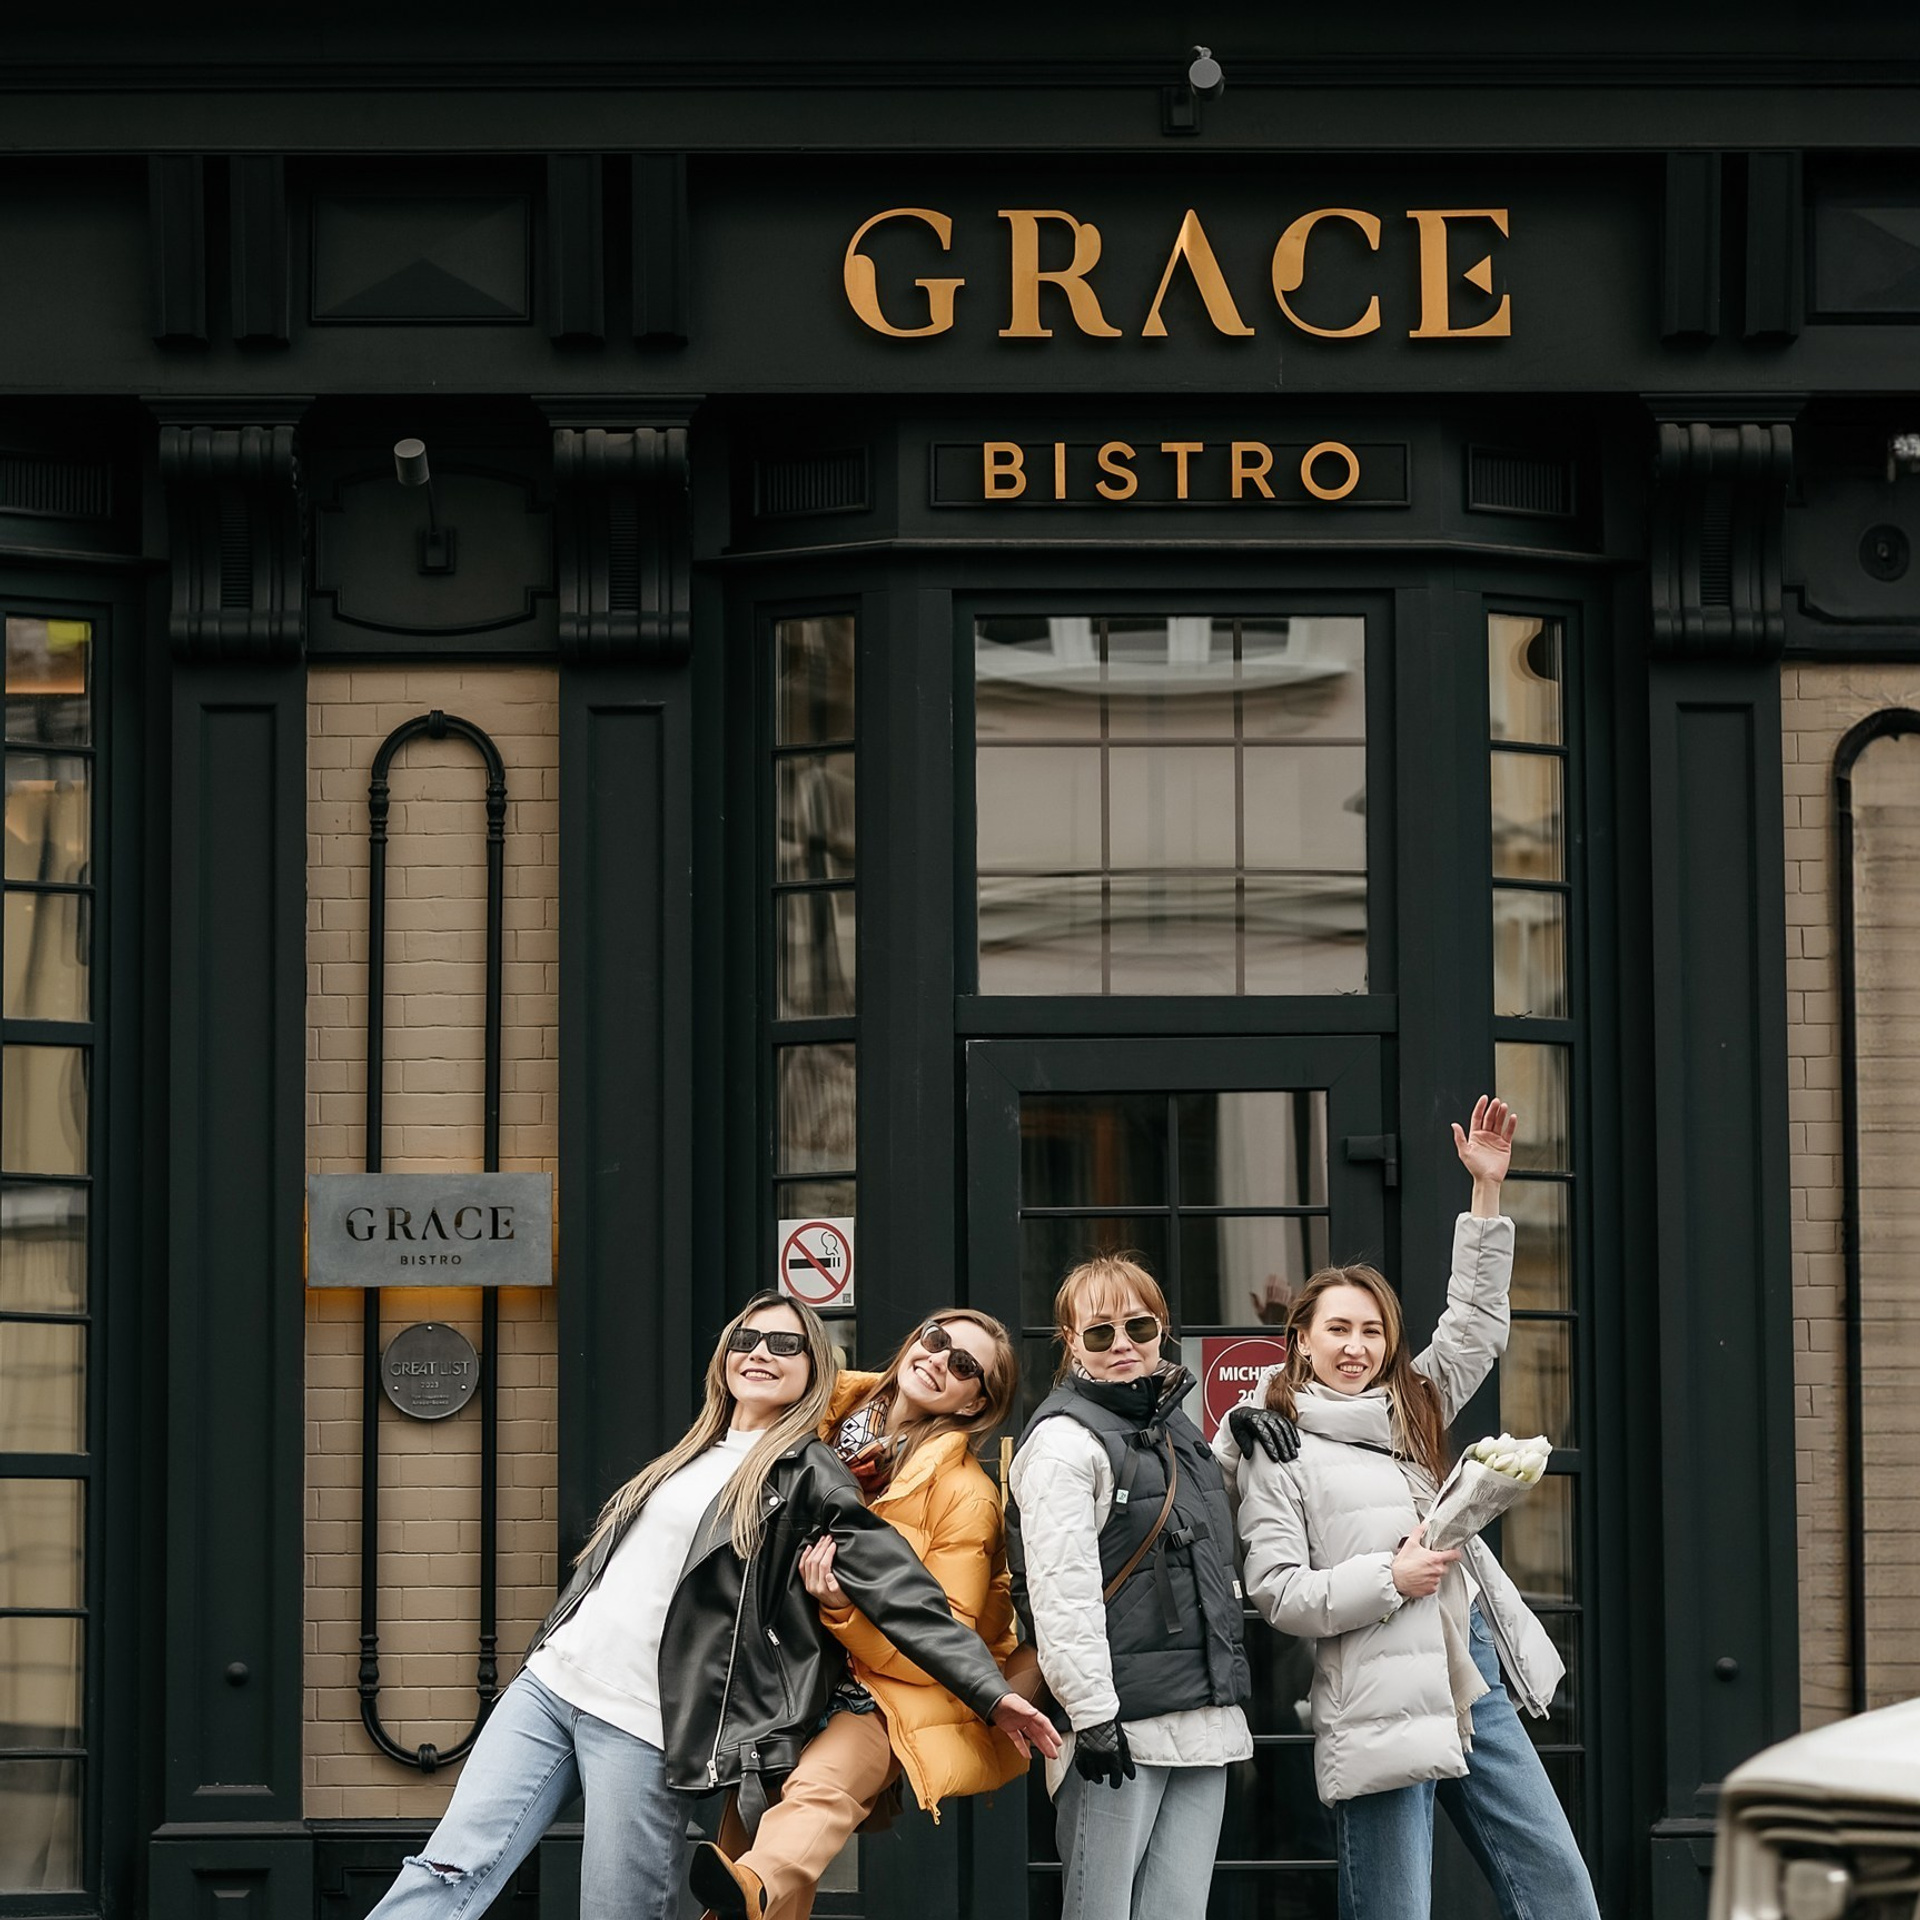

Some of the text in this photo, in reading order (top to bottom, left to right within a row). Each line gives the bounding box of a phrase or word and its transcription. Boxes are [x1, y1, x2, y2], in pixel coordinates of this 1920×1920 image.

[844, 207, 1511, 338] GRACE
[983, 440, 1361, 501] BISTRO
[345, 1206, 515, 1241] GRACE
[400, 1255, 462, 1266] BISTRO
[390, 1361, 470, 1375] GREAT LIST
[1238, 1389, 1256, 1403] 20
